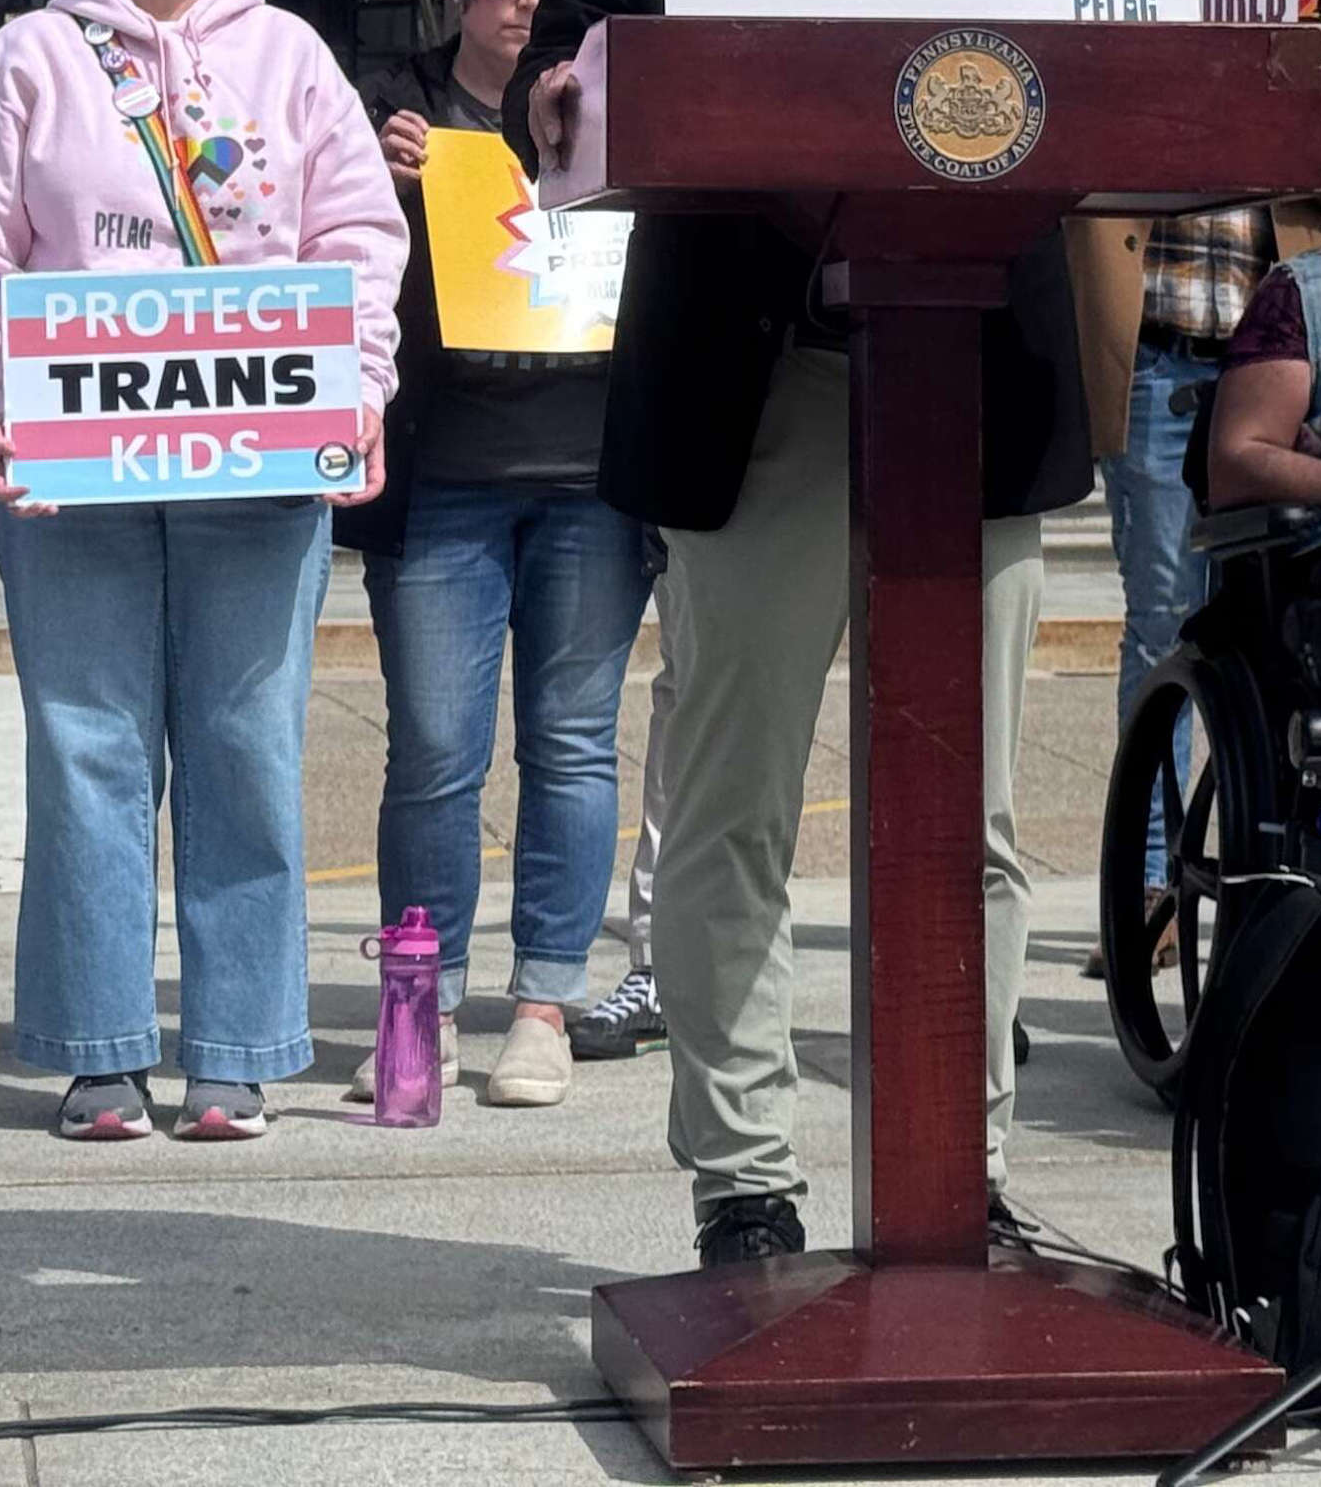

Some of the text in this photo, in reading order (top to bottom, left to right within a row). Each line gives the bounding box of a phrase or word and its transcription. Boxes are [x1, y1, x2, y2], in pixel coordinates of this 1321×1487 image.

[904, 31, 1035, 84] PENNSYLVANIA
[899, 104, 1041, 178] STATE COAT OF ARMS
[93, 211, 154, 250] PFLAG
[44, 284, 320, 340] PROTECT
[48, 353, 317, 414] TRANS
[110, 429, 263, 483] KIDS
